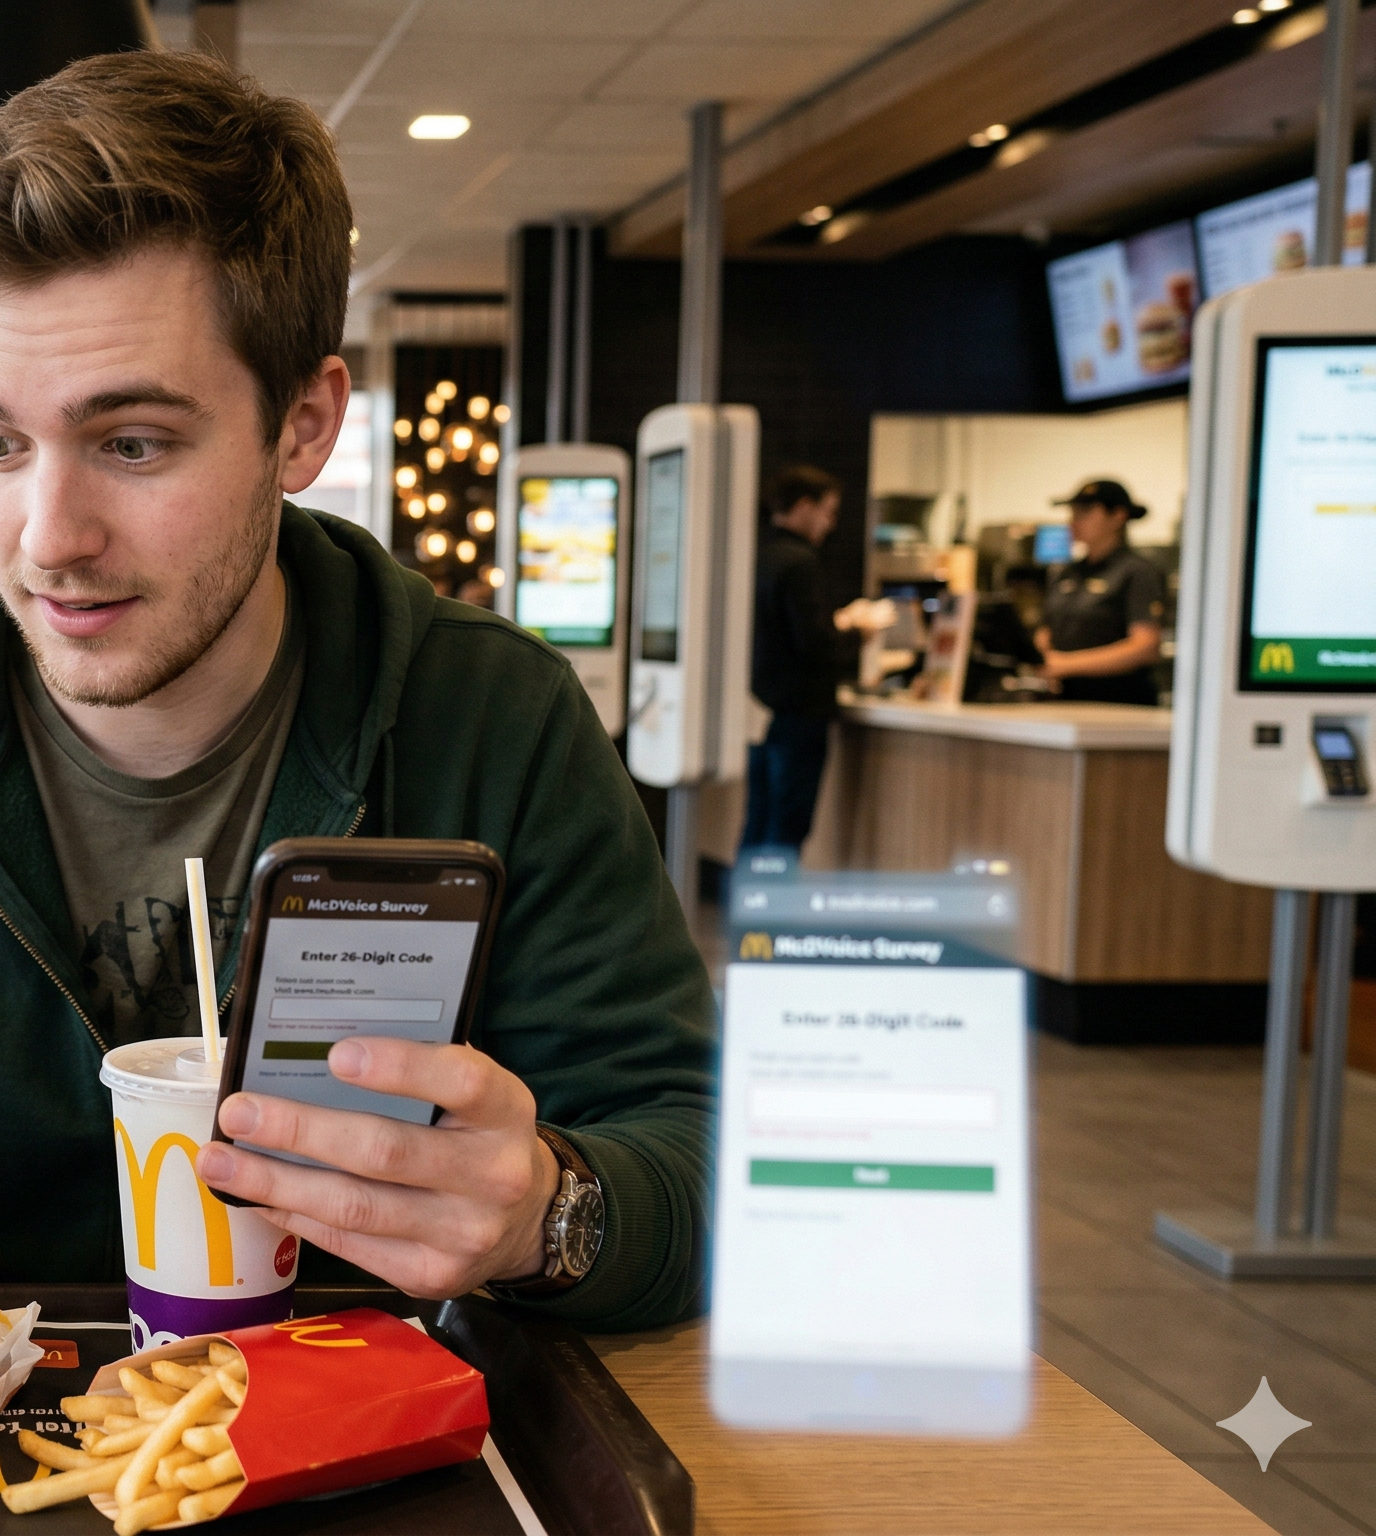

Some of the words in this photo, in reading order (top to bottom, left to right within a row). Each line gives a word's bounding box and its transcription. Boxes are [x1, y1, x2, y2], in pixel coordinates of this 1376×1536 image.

[380, 900, 429, 916] Survey
[301, 951, 338, 962] Enter
[340, 951, 395, 965] 26-Digit
[398, 952, 433, 964] Code
[874, 935, 944, 965] Survey
[781, 1010, 832, 1027] Enter
[915, 1013, 966, 1030] Code
